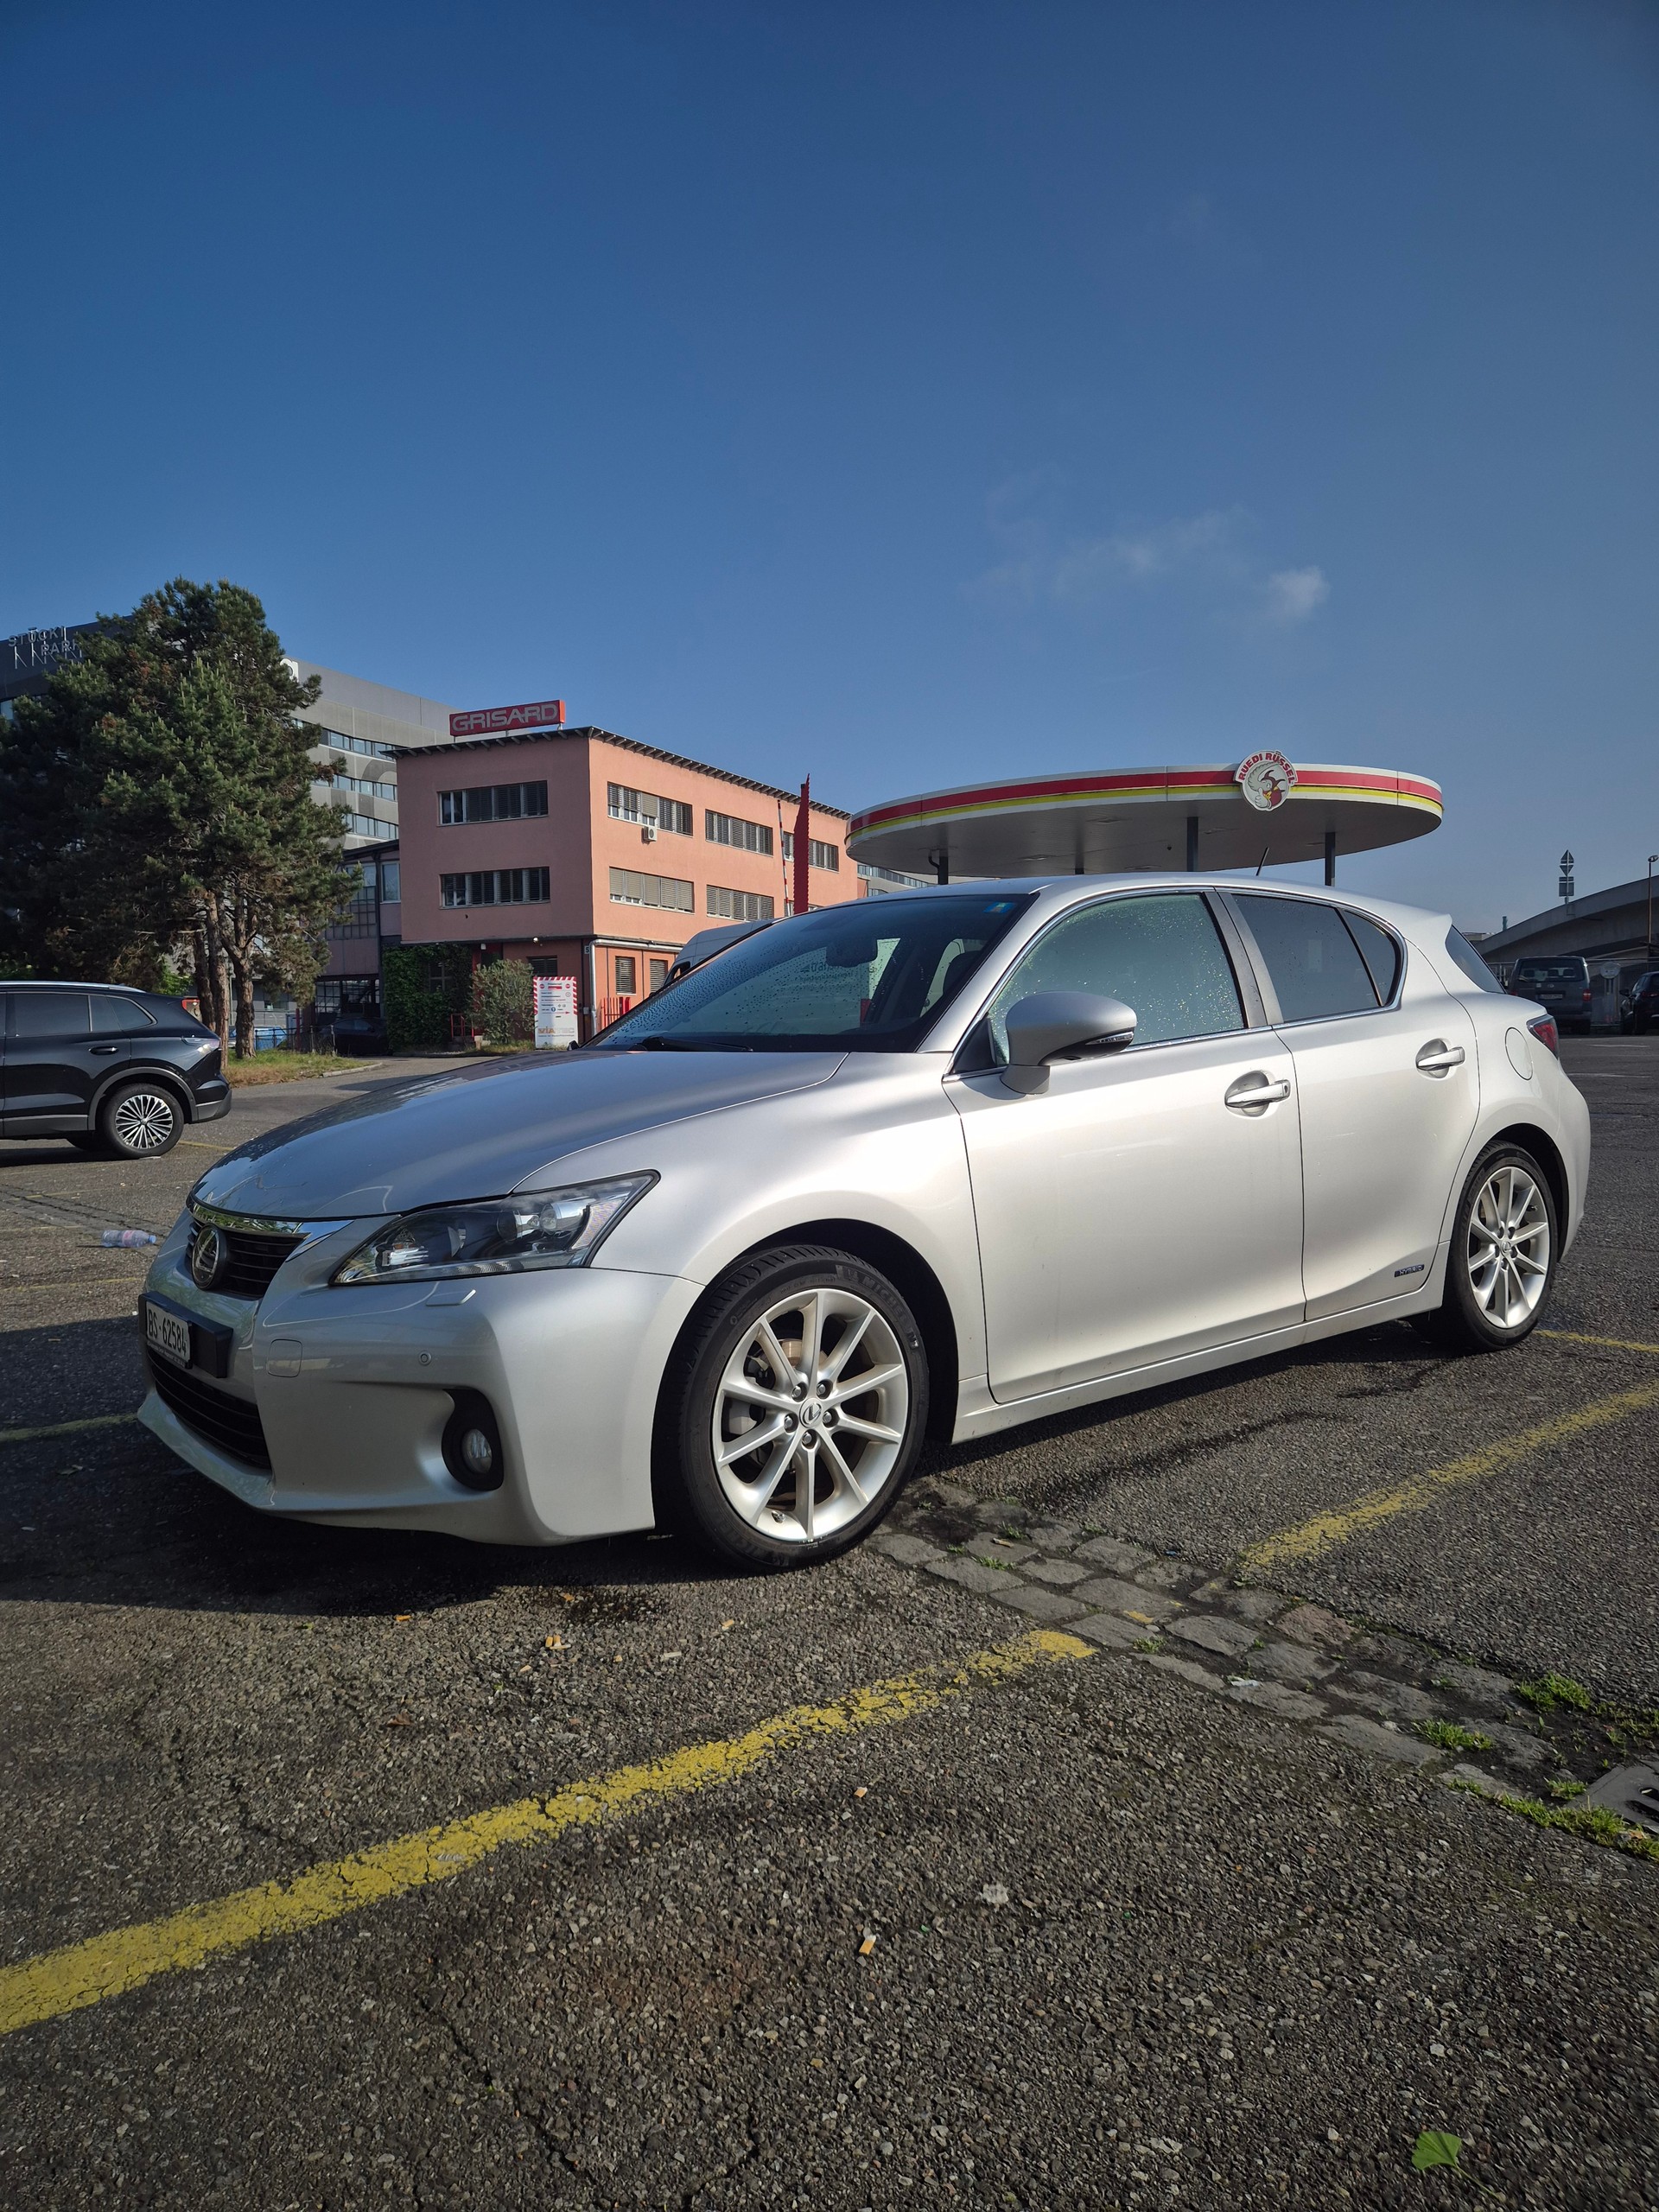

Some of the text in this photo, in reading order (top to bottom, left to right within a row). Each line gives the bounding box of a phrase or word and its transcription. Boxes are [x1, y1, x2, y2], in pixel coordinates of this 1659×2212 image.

[452, 703, 558, 732] GRISARD
[1238, 751, 1295, 784] RUEDI RÜSSEL
[162, 1317, 187, 1357] 62584
